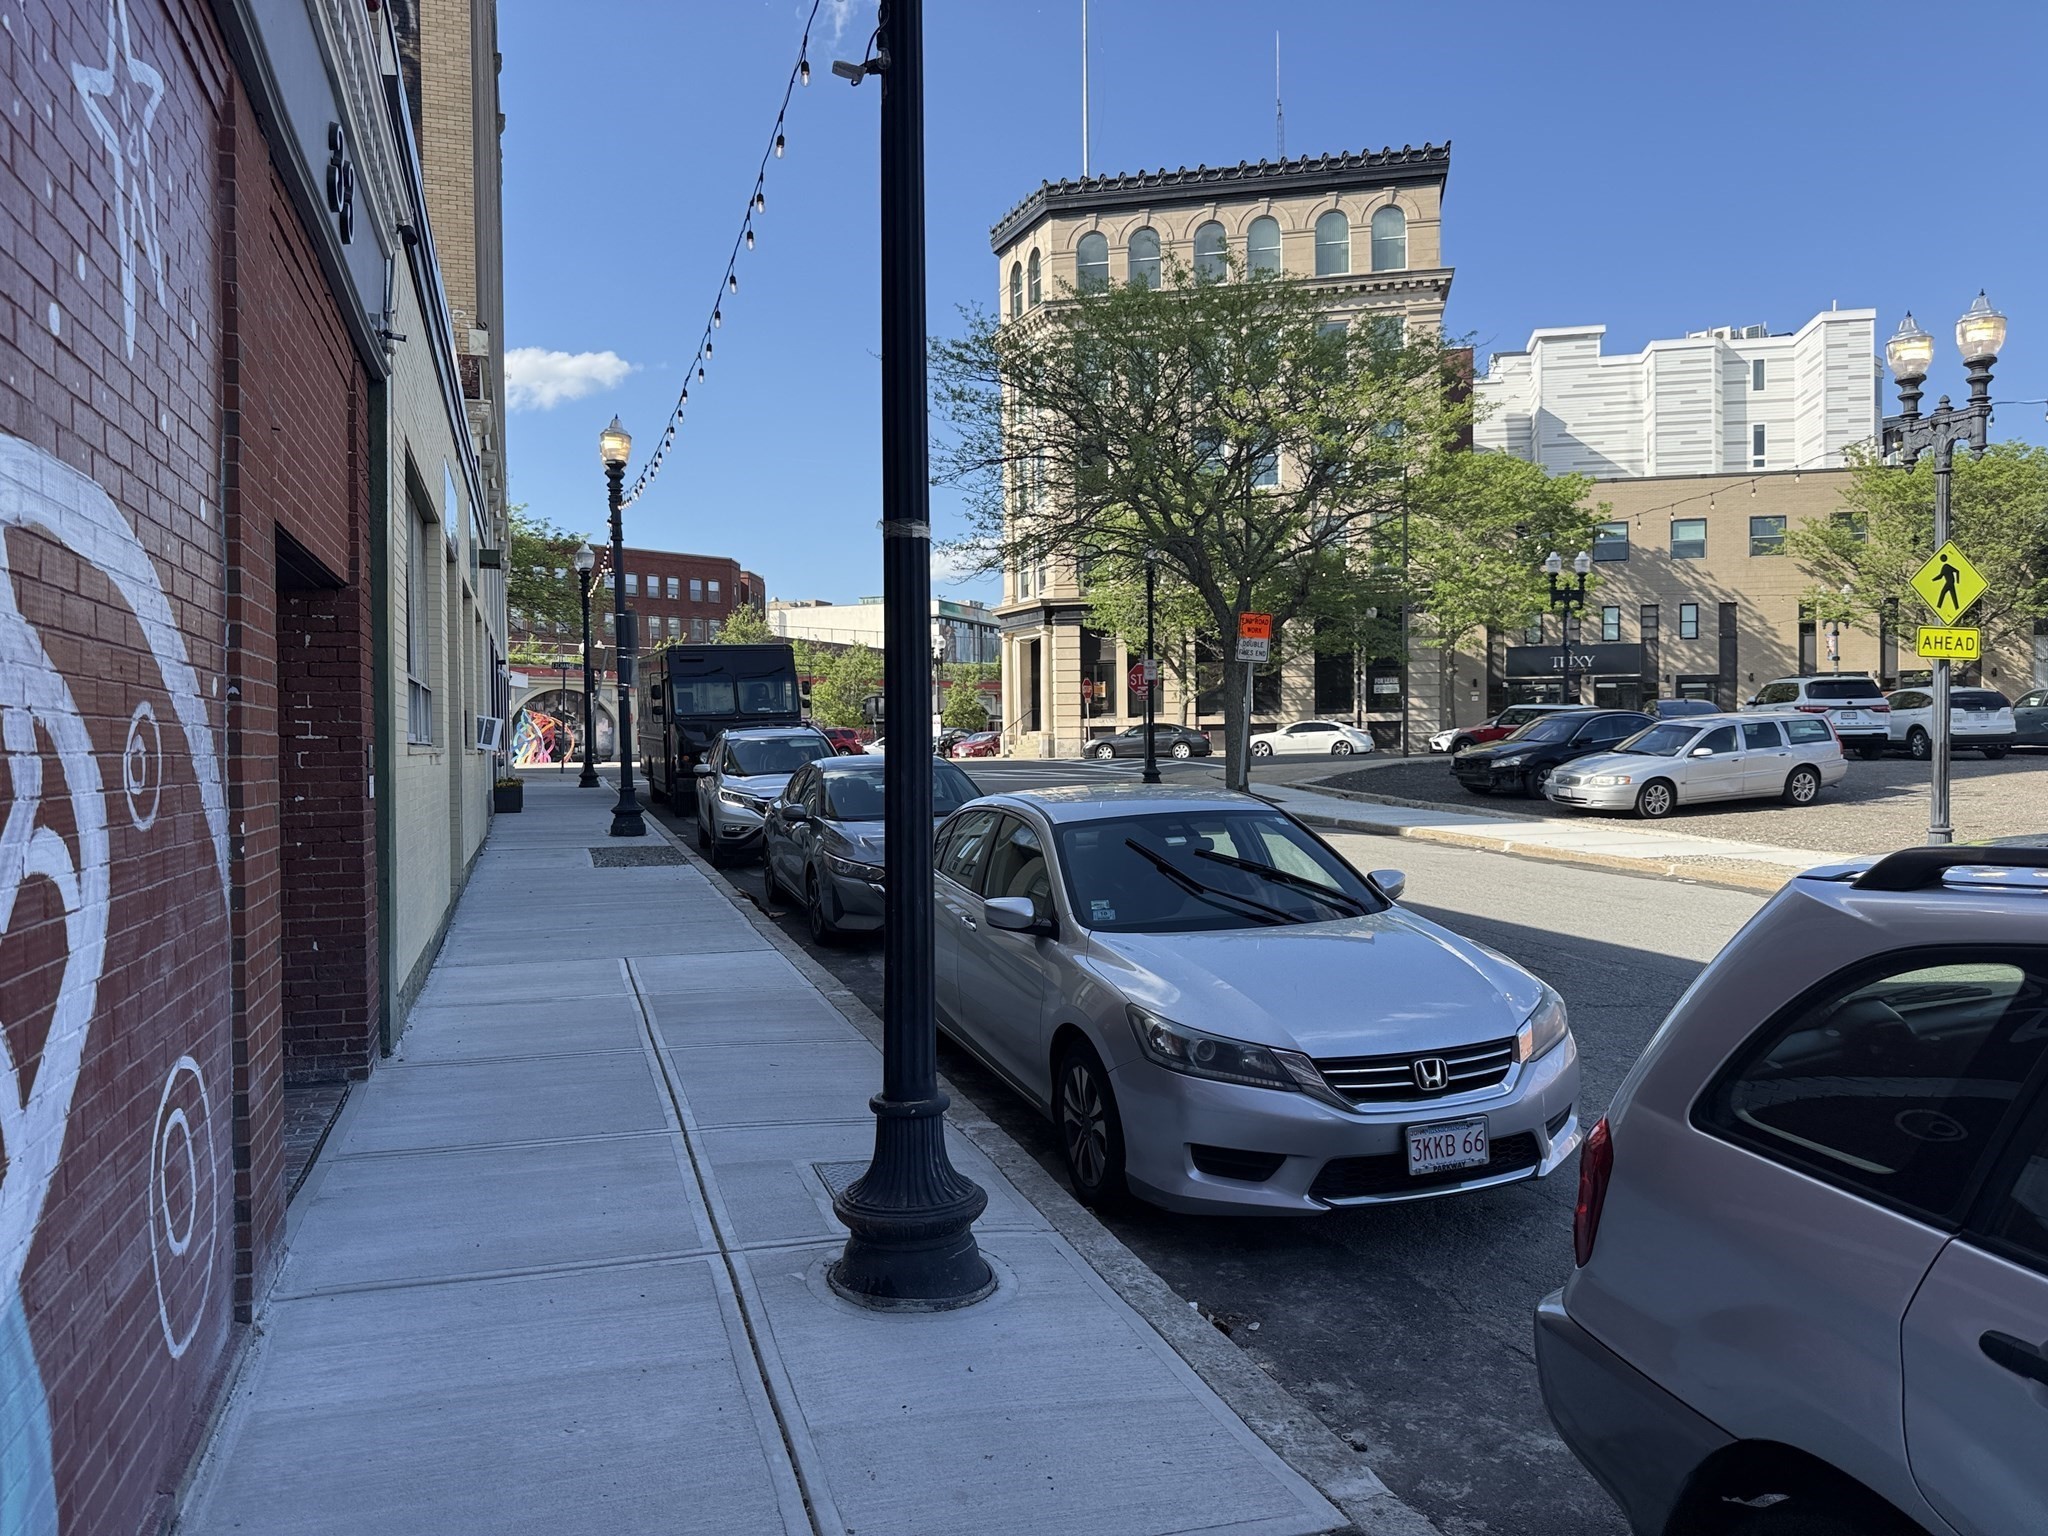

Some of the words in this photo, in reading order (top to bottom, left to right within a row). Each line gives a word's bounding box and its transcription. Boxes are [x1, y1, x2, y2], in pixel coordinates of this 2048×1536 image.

[1242, 641, 1264, 649] DOUBLE
[1921, 635, 1975, 651] AHEAD
[1255, 650, 1267, 658] END
[1411, 1133, 1456, 1162] 3KKB
[1462, 1129, 1485, 1154] 66
[1433, 1161, 1466, 1173] PARKWAY
